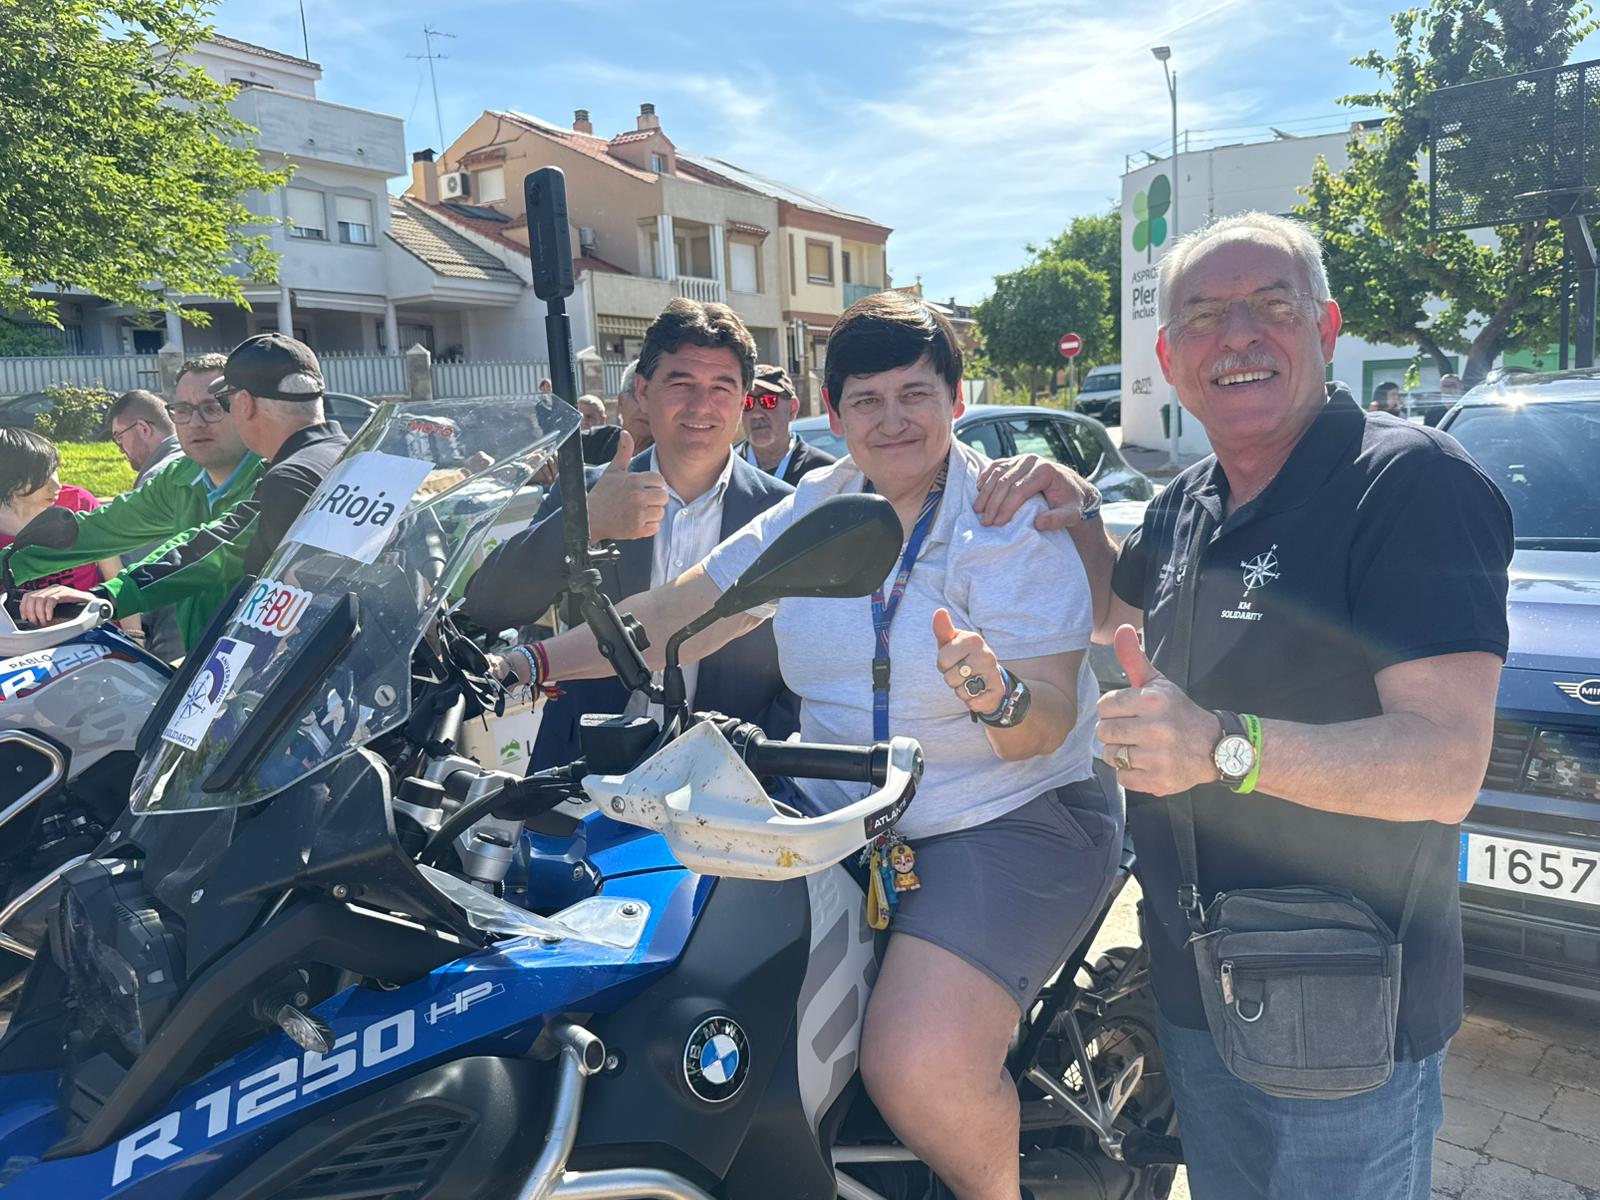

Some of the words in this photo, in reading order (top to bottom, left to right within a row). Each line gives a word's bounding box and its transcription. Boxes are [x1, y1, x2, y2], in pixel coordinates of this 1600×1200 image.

[1132, 306, 1157, 320] inclus
[319, 484, 395, 527] Rioja
[1220, 609, 1263, 621] SOLIDARITY
[9, 654, 53, 669] PABLO
[1485, 844, 1598, 894] 1657
[112, 1110, 183, 1187] R
[196, 1009, 415, 1138] 1250
[429, 981, 493, 1025] HP
